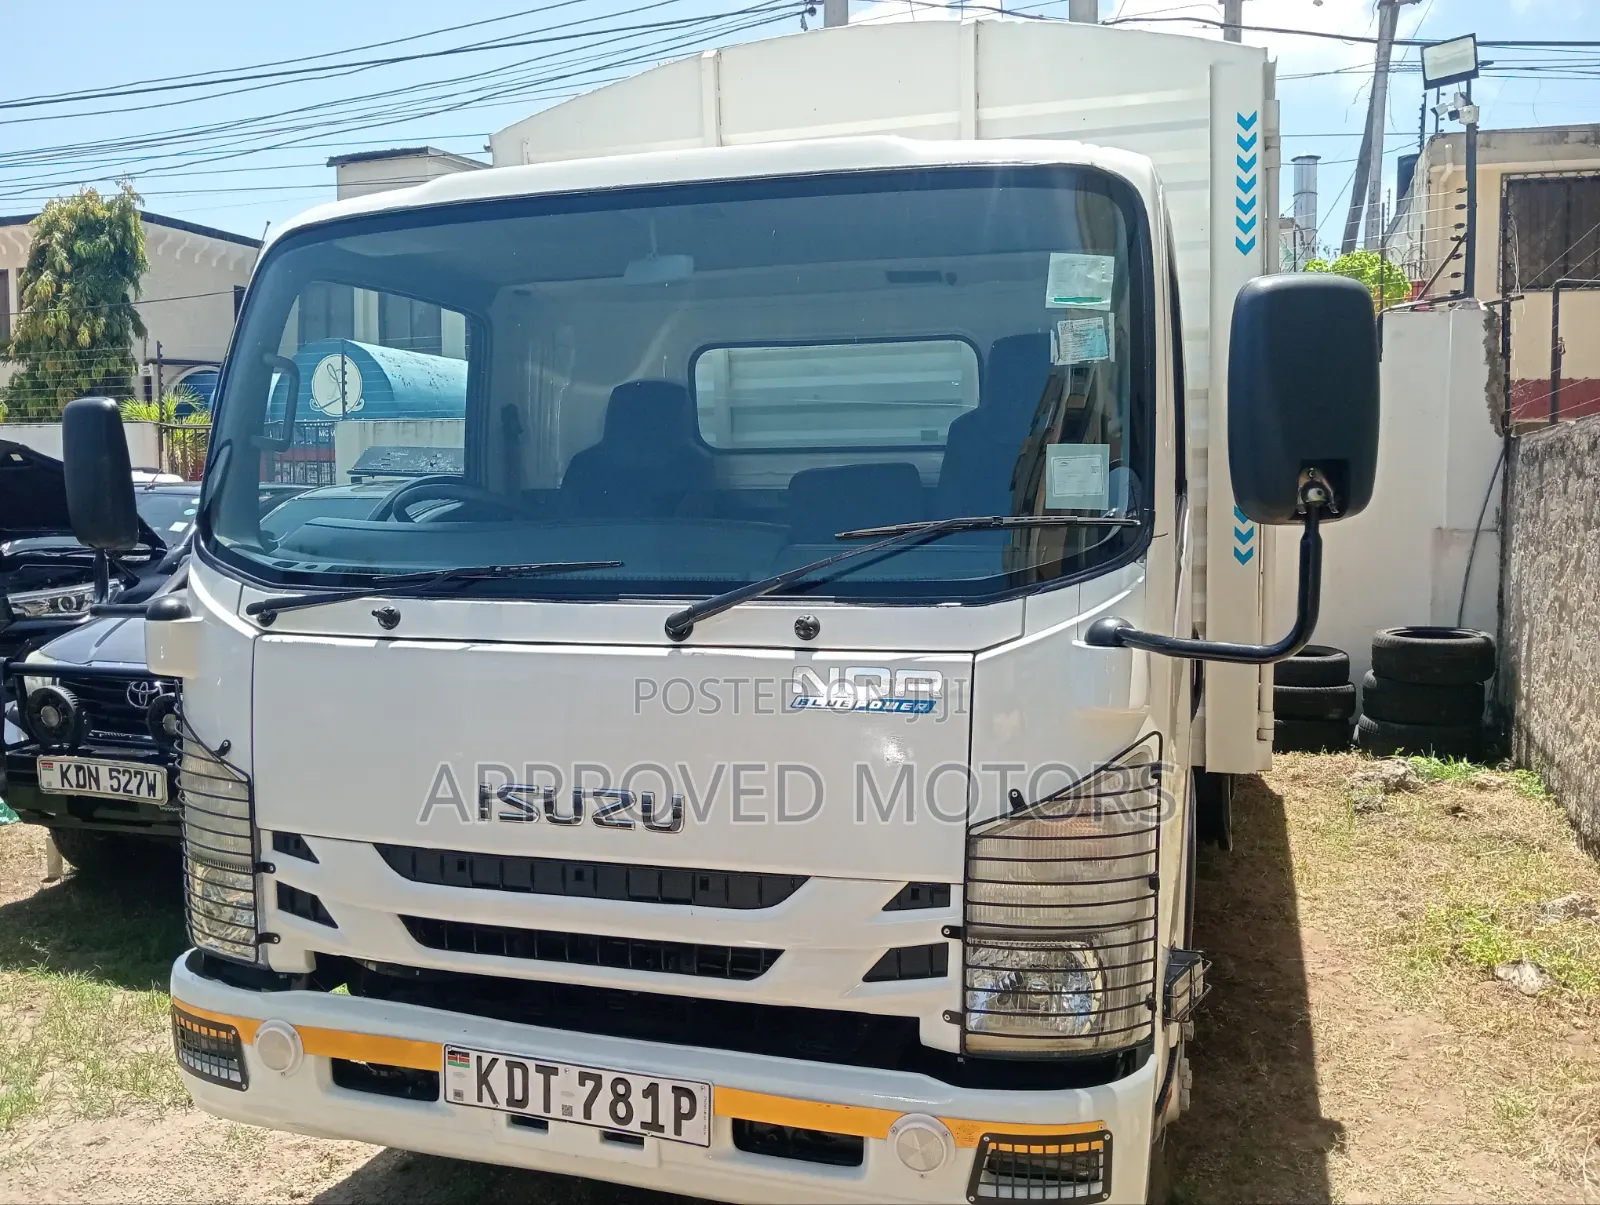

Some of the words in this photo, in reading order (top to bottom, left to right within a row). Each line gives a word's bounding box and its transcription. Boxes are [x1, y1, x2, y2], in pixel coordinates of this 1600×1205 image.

[791, 665, 943, 699] NQR
[60, 763, 101, 791] KDN
[108, 767, 157, 798] 527W
[478, 781, 685, 834] ISUZU
[476, 1055, 559, 1114] KDT
[578, 1071, 698, 1137] 781P
